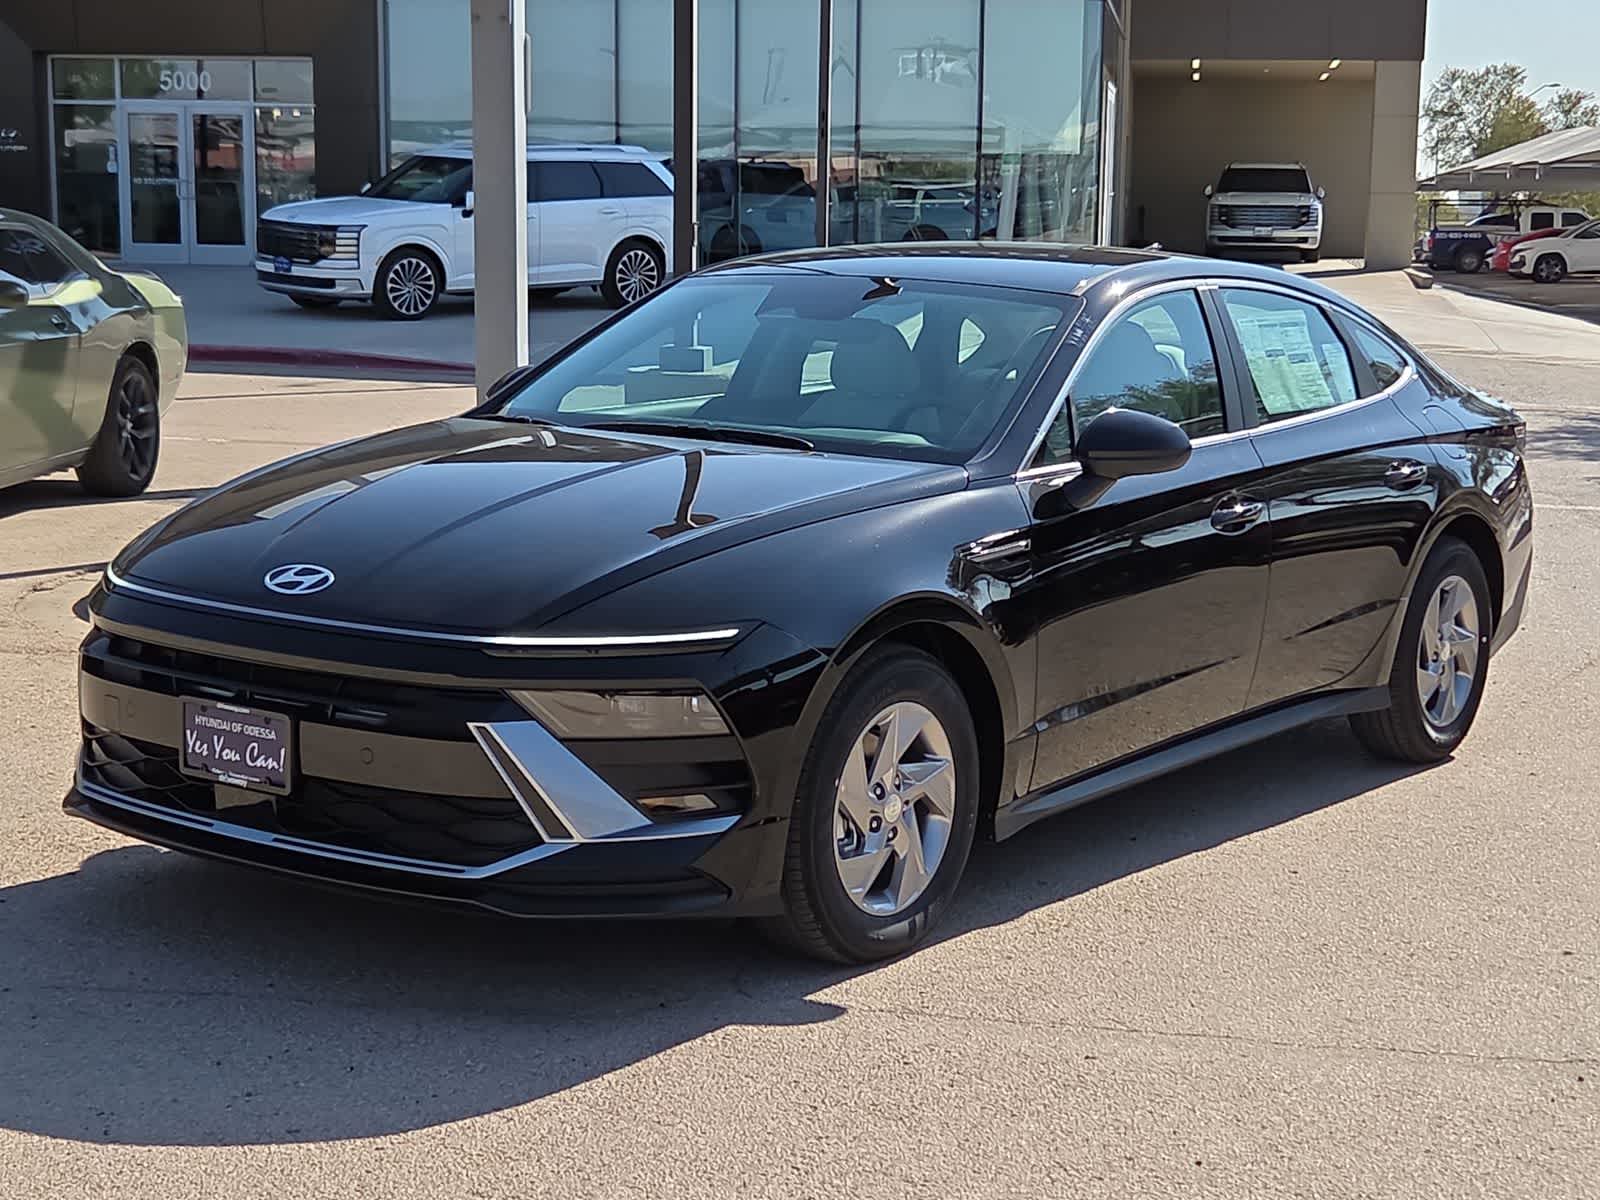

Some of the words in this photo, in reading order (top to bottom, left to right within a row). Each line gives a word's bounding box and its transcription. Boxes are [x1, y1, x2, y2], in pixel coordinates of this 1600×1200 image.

[160, 69, 211, 92] 5000
[194, 714, 231, 733] HYUNDAI
[231, 722, 242, 733] OF
[243, 724, 277, 741] ODESSA
[185, 729, 209, 757] Yes
[213, 734, 241, 762] You
[245, 742, 286, 773] Can!
